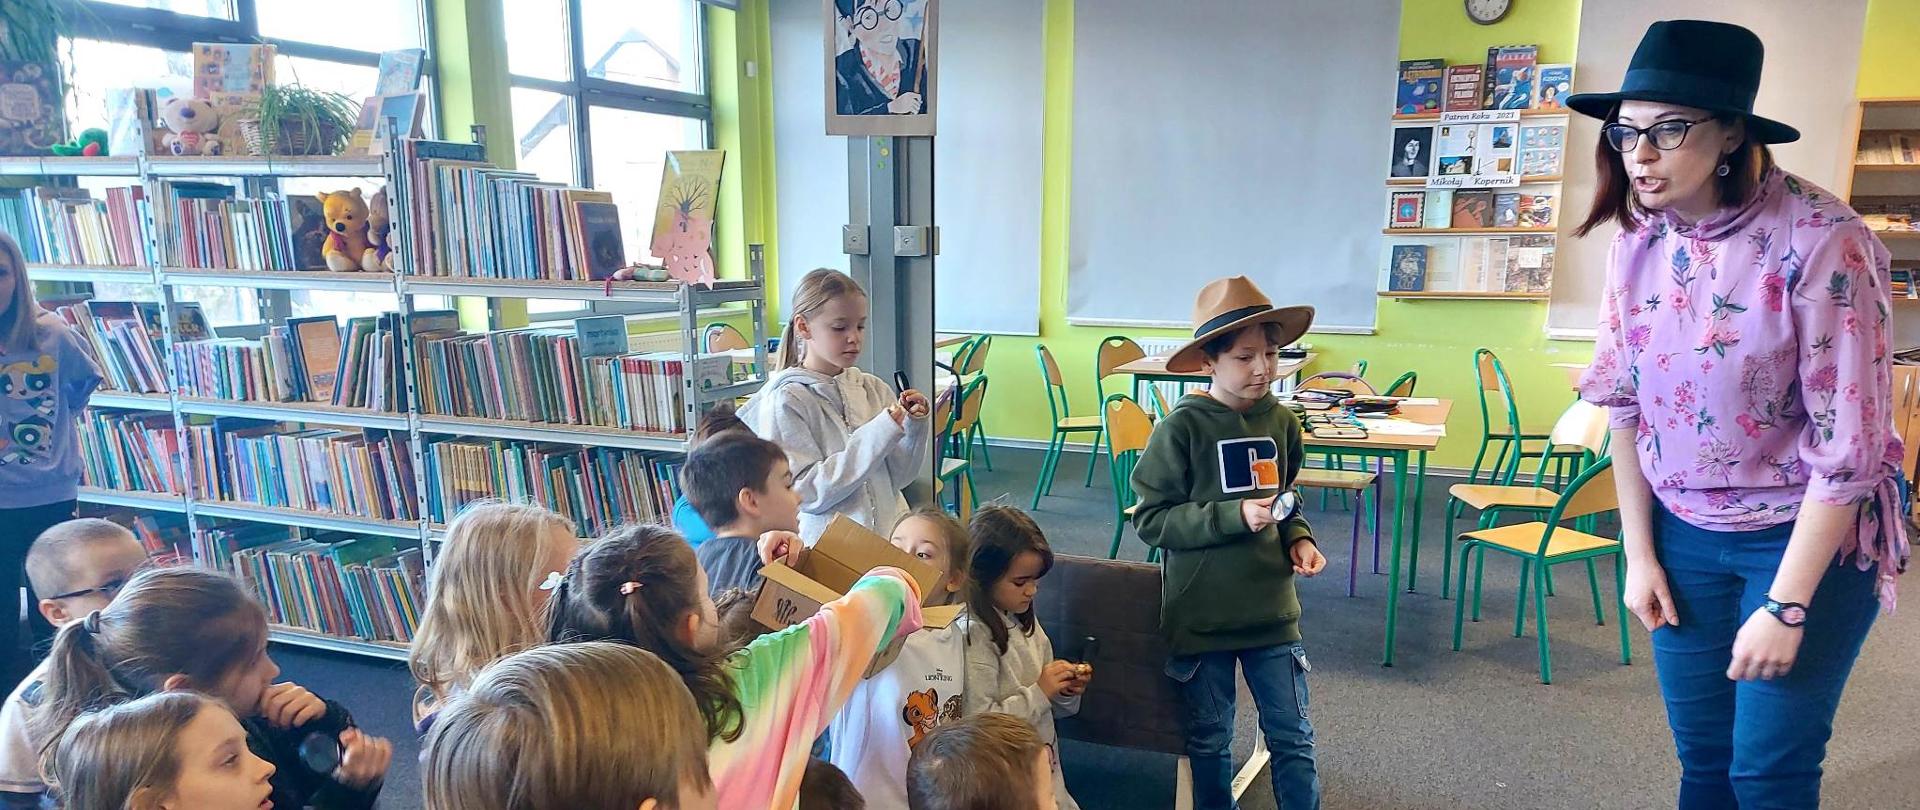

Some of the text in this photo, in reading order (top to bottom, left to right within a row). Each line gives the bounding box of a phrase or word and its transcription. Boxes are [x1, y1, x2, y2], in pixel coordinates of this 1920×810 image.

[1444, 113, 1470, 121] Patron
[1472, 112, 1491, 120] Roku
[1430, 176, 1514, 187] Mikołaj Kopernik
